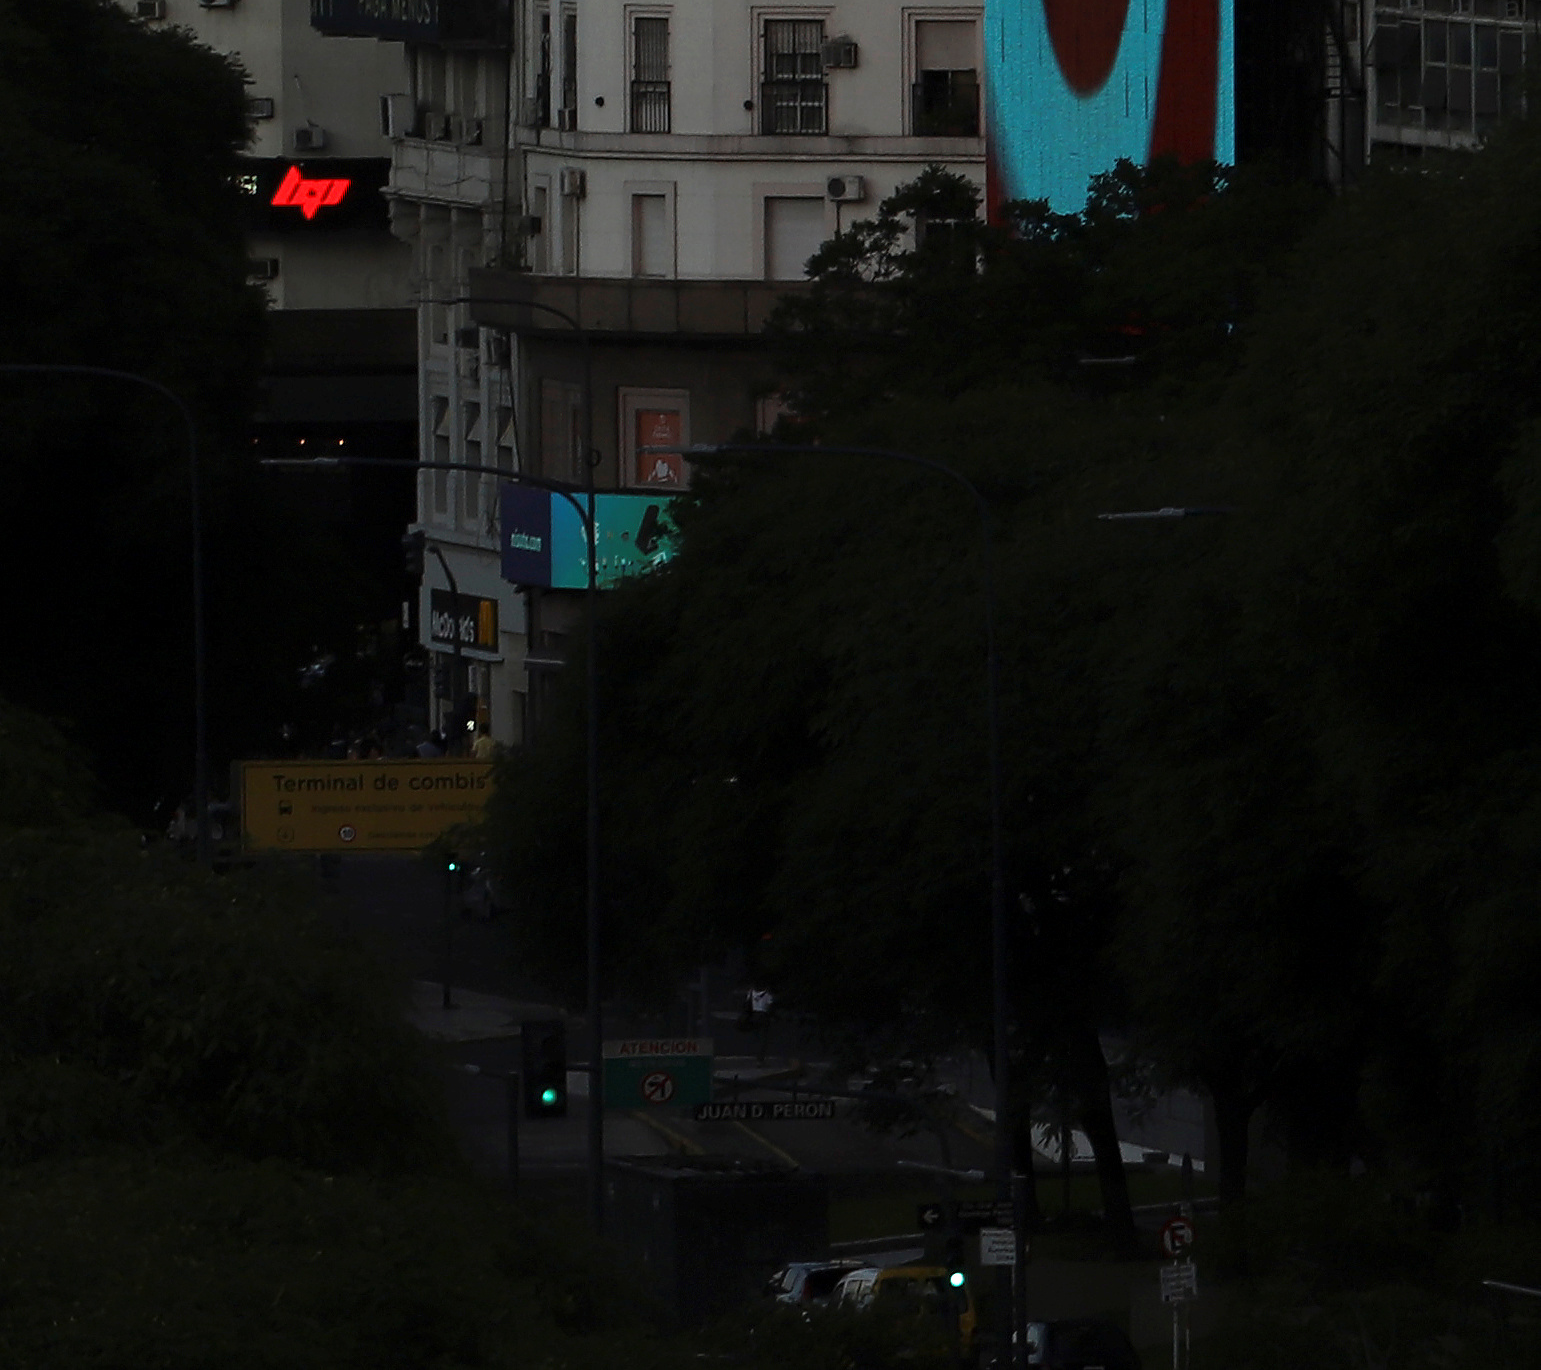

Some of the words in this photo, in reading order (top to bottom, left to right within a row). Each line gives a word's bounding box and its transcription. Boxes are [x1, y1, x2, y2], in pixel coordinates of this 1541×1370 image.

[274, 773, 364, 792] Terminal
[373, 772, 400, 792] de
[409, 771, 487, 791] combis
[698, 1105, 747, 1120] JUAN
